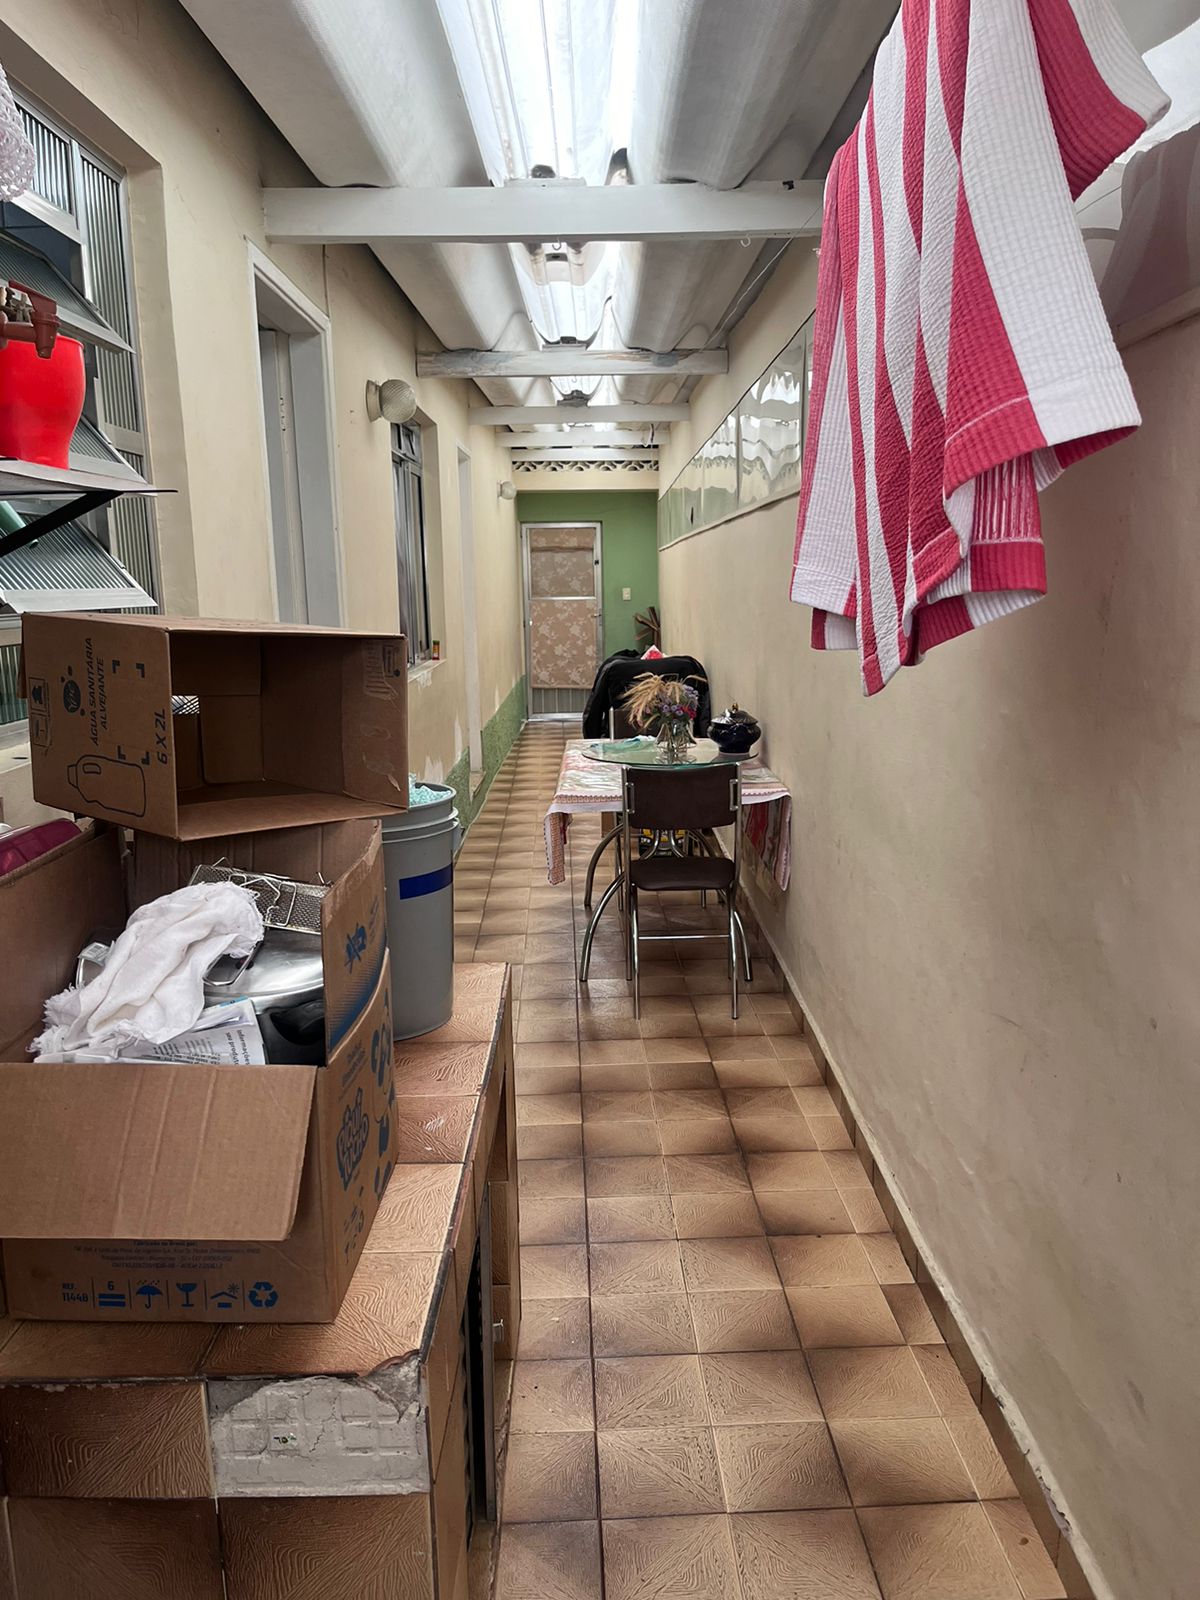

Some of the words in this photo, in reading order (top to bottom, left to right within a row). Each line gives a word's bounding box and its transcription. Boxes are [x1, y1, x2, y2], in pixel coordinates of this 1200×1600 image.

[96, 657, 107, 730] ALVEJANTE
[154, 708, 166, 731] 2L
[155, 732, 168, 749] X
[157, 751, 168, 765] 6
[107, 1280, 115, 1291] 6
